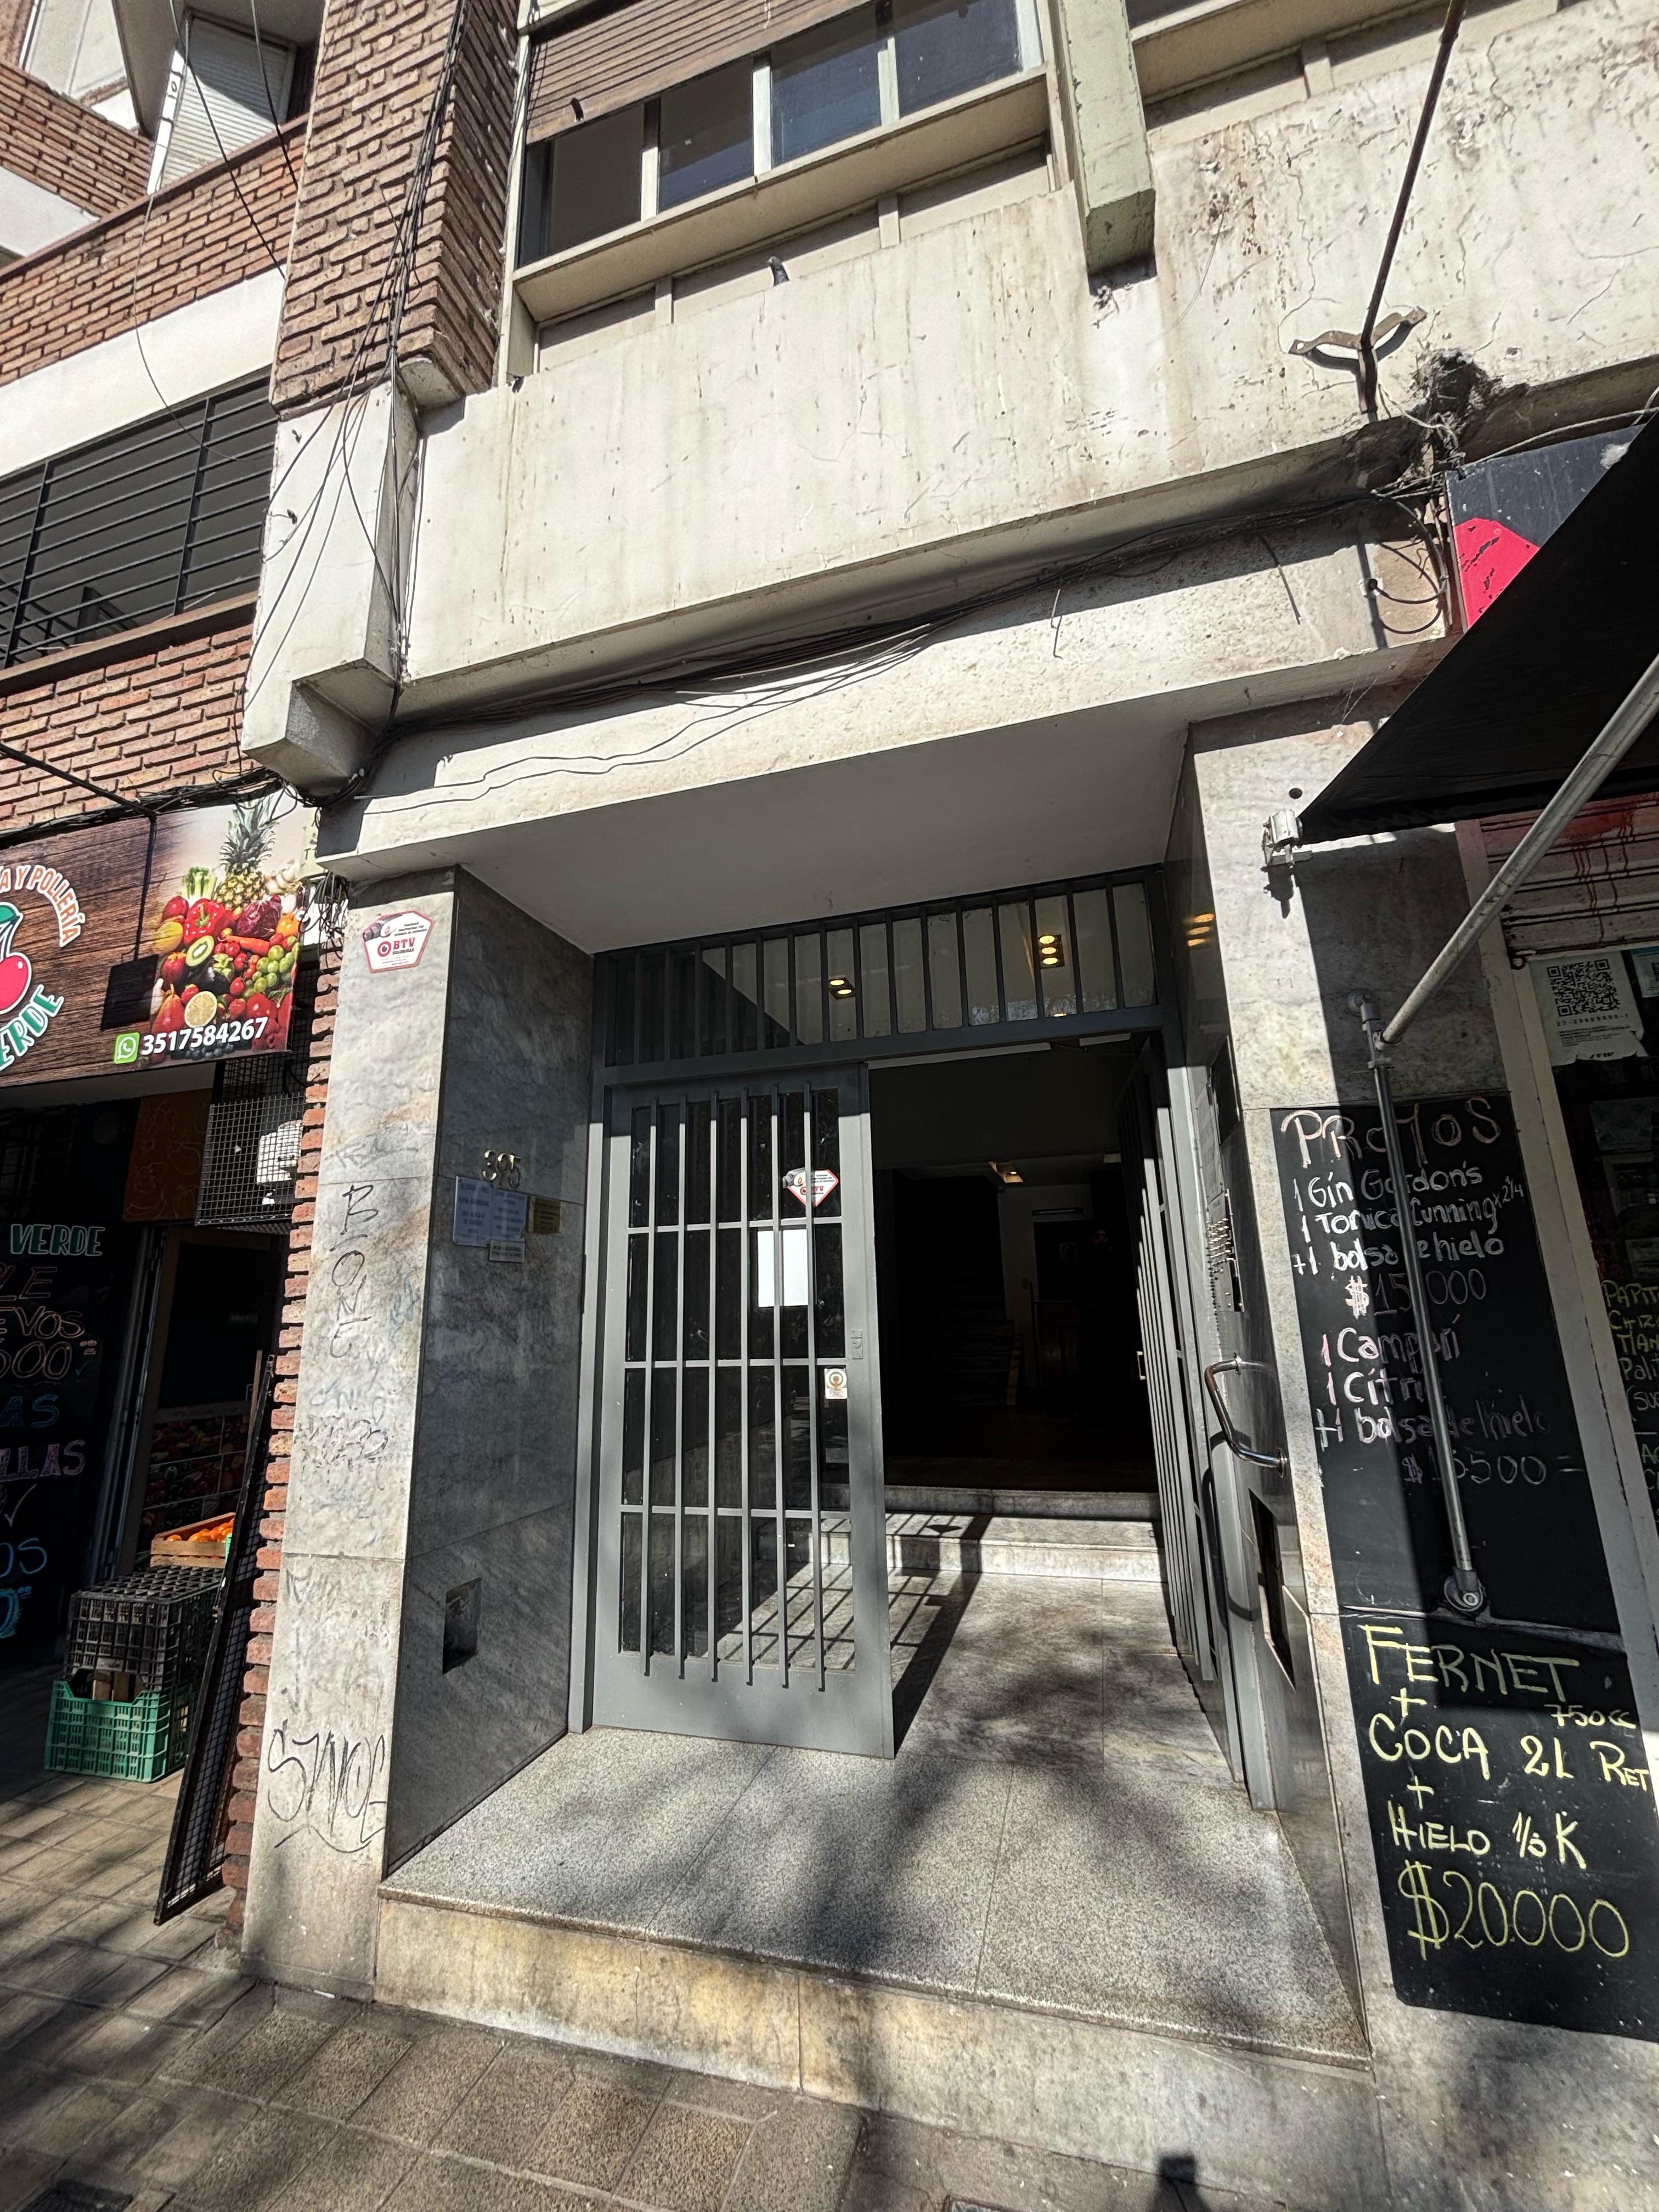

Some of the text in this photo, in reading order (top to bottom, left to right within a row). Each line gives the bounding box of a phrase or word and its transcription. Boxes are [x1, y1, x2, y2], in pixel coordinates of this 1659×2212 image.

[15, 866, 30, 889] Y
[27, 865, 85, 947] POLLERÍA
[393, 937, 415, 950] BTV
[140, 1017, 268, 1056] 3517584267
[10, 1223, 105, 1257] VERDE
[1330, 1237, 1400, 1272] bolsa
[1432, 1229, 1506, 1262] hielo
[1358, 1624, 1580, 1702] FERNET
[1369, 1713, 1490, 1781] COCA
[1387, 1799, 1491, 1852] HIELO
